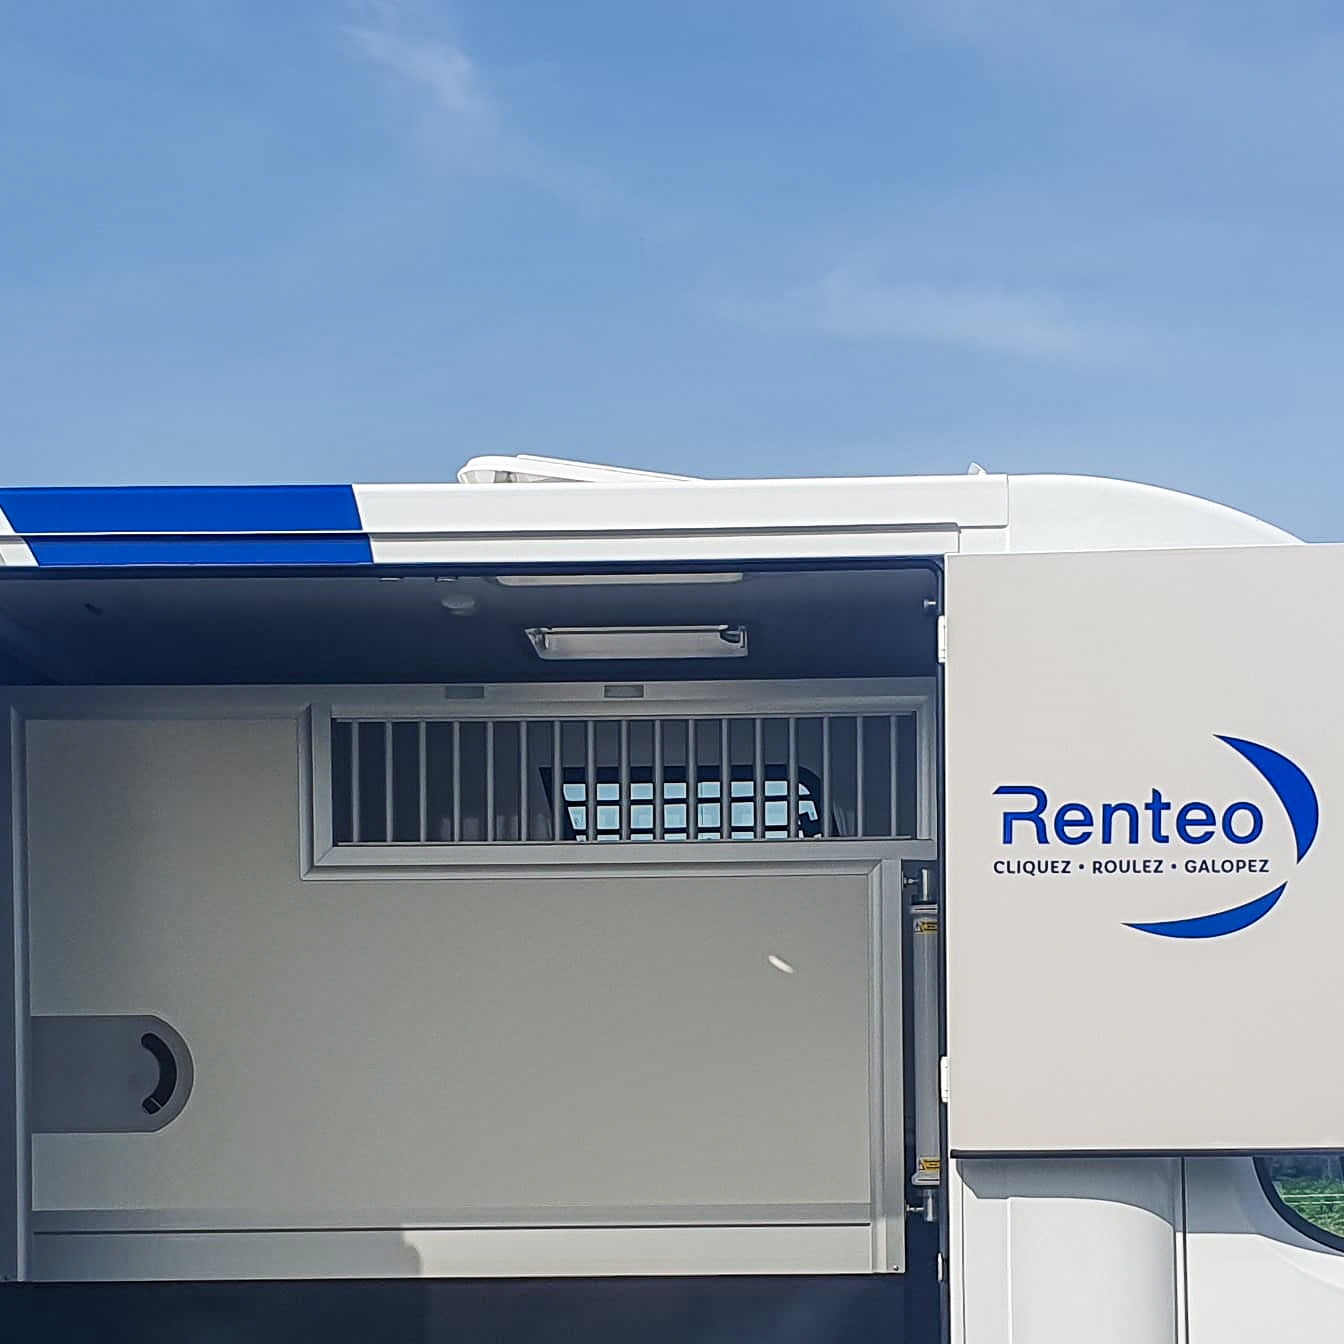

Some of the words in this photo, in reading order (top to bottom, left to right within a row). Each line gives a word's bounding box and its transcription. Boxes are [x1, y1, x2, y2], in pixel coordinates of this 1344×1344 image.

[992, 785, 1264, 845] Renteo
[993, 859, 1072, 877] CLIQUEZ
[1092, 858, 1164, 875] ROULEZ
[1184, 858, 1270, 874] GALOPEZ
